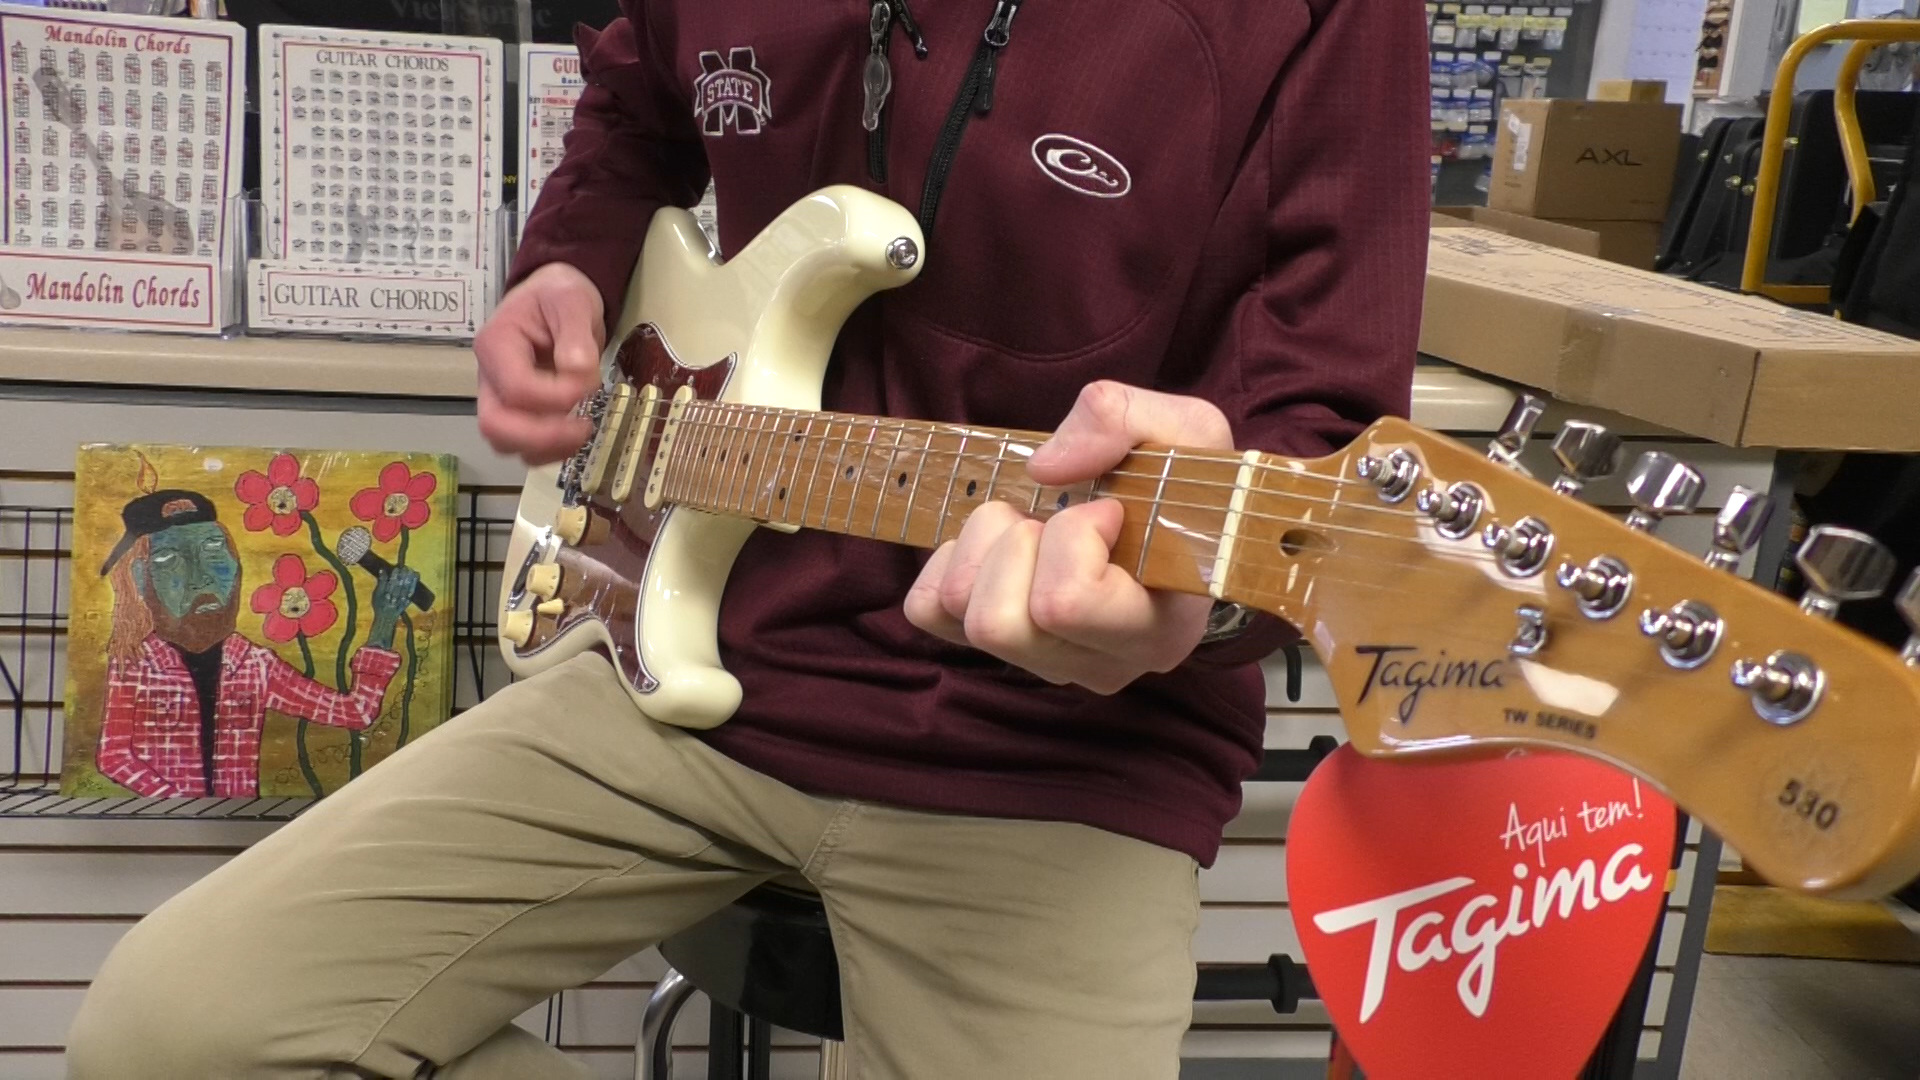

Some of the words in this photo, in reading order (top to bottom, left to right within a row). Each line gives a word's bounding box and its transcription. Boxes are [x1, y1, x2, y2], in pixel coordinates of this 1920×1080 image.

[44, 25, 128, 48] Mandolin
[134, 33, 191, 54] Chords
[316, 50, 378, 67] GUITAR
[385, 53, 450, 72] CHORDS
[552, 57, 580, 74] GUI
[707, 76, 753, 103] STATE
[1575, 147, 1643, 167] AXL
[26, 271, 124, 304] Mandolin
[132, 275, 200, 309] Chords
[274, 283, 360, 309] GUITAR
[370, 287, 459, 312] CHORDS
[1355, 645, 1504, 724] Tagima
[1503, 708, 1529, 724] TW
[1535, 711, 1597, 740] SERIES
[1779, 779, 1840, 831] 530
[1499, 801, 1568, 868] Aqui
[1576, 777, 1644, 833] tem!
[1312, 842, 1653, 1024] Tagima
